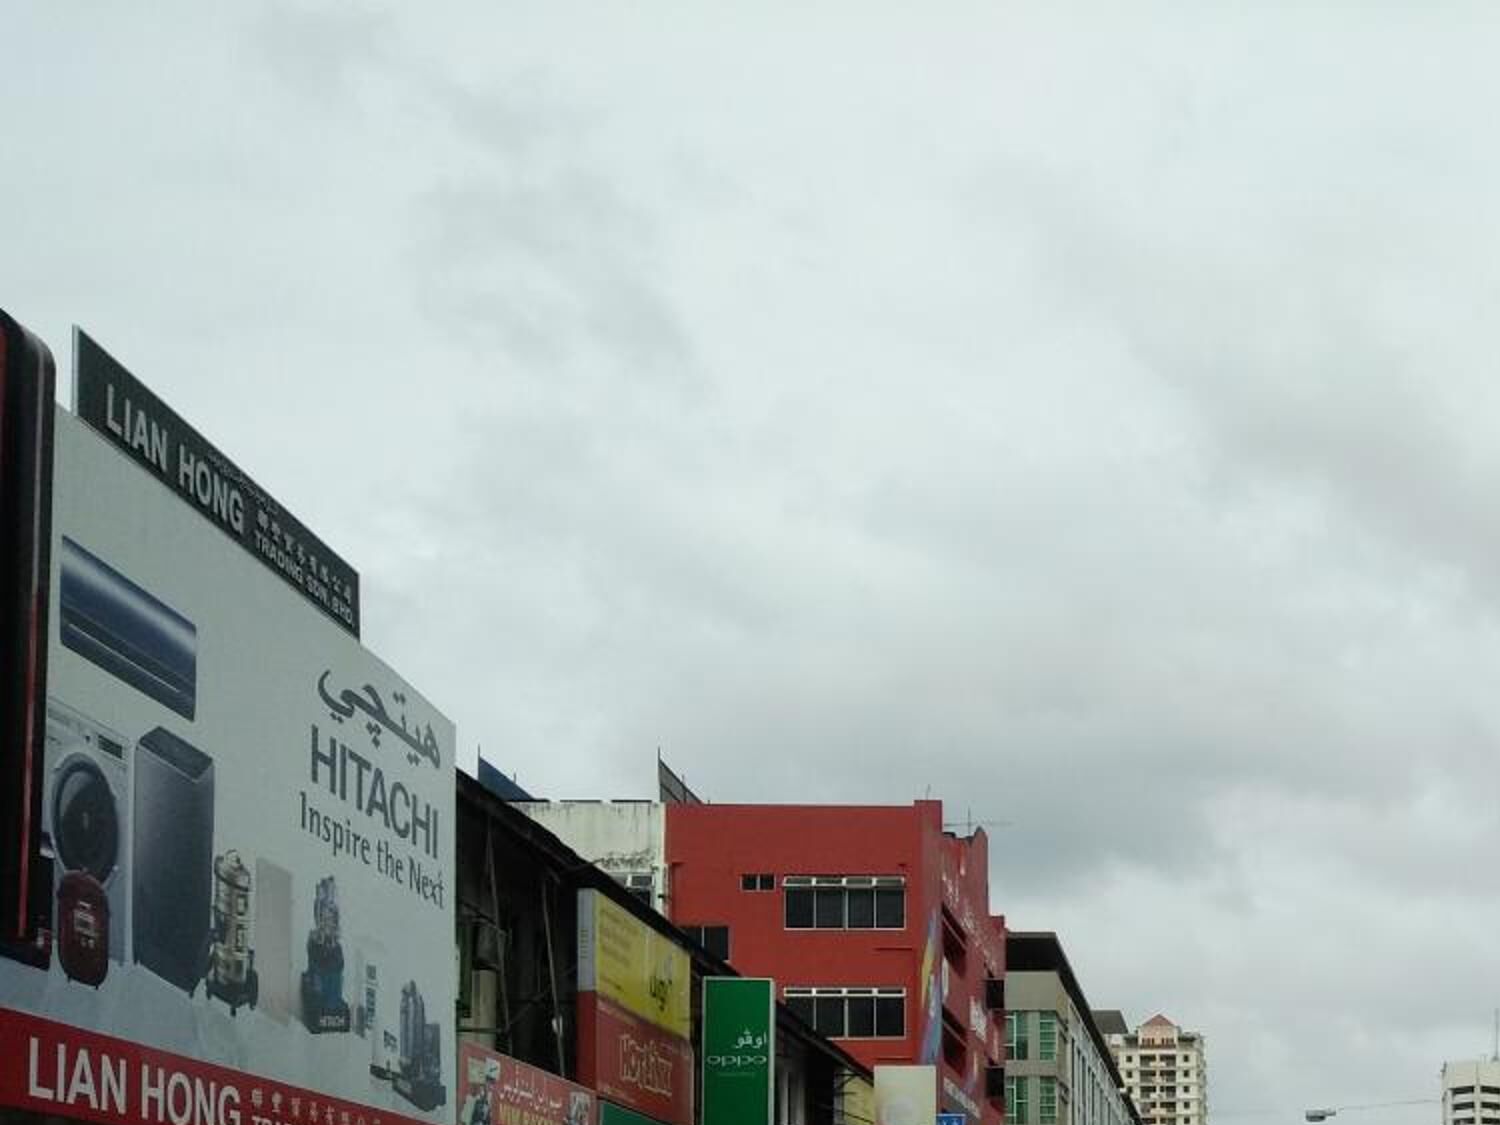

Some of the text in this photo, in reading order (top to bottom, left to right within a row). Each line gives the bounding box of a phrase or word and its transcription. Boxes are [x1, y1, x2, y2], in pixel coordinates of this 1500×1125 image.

[107, 383, 168, 474] LIAN
[178, 443, 244, 536] HONG
[253, 532, 303, 584] TRADING
[300, 791, 445, 910] Inspire the Next
[311, 723, 438, 860] HITACHI
[29, 1036, 127, 1116] LIAN
